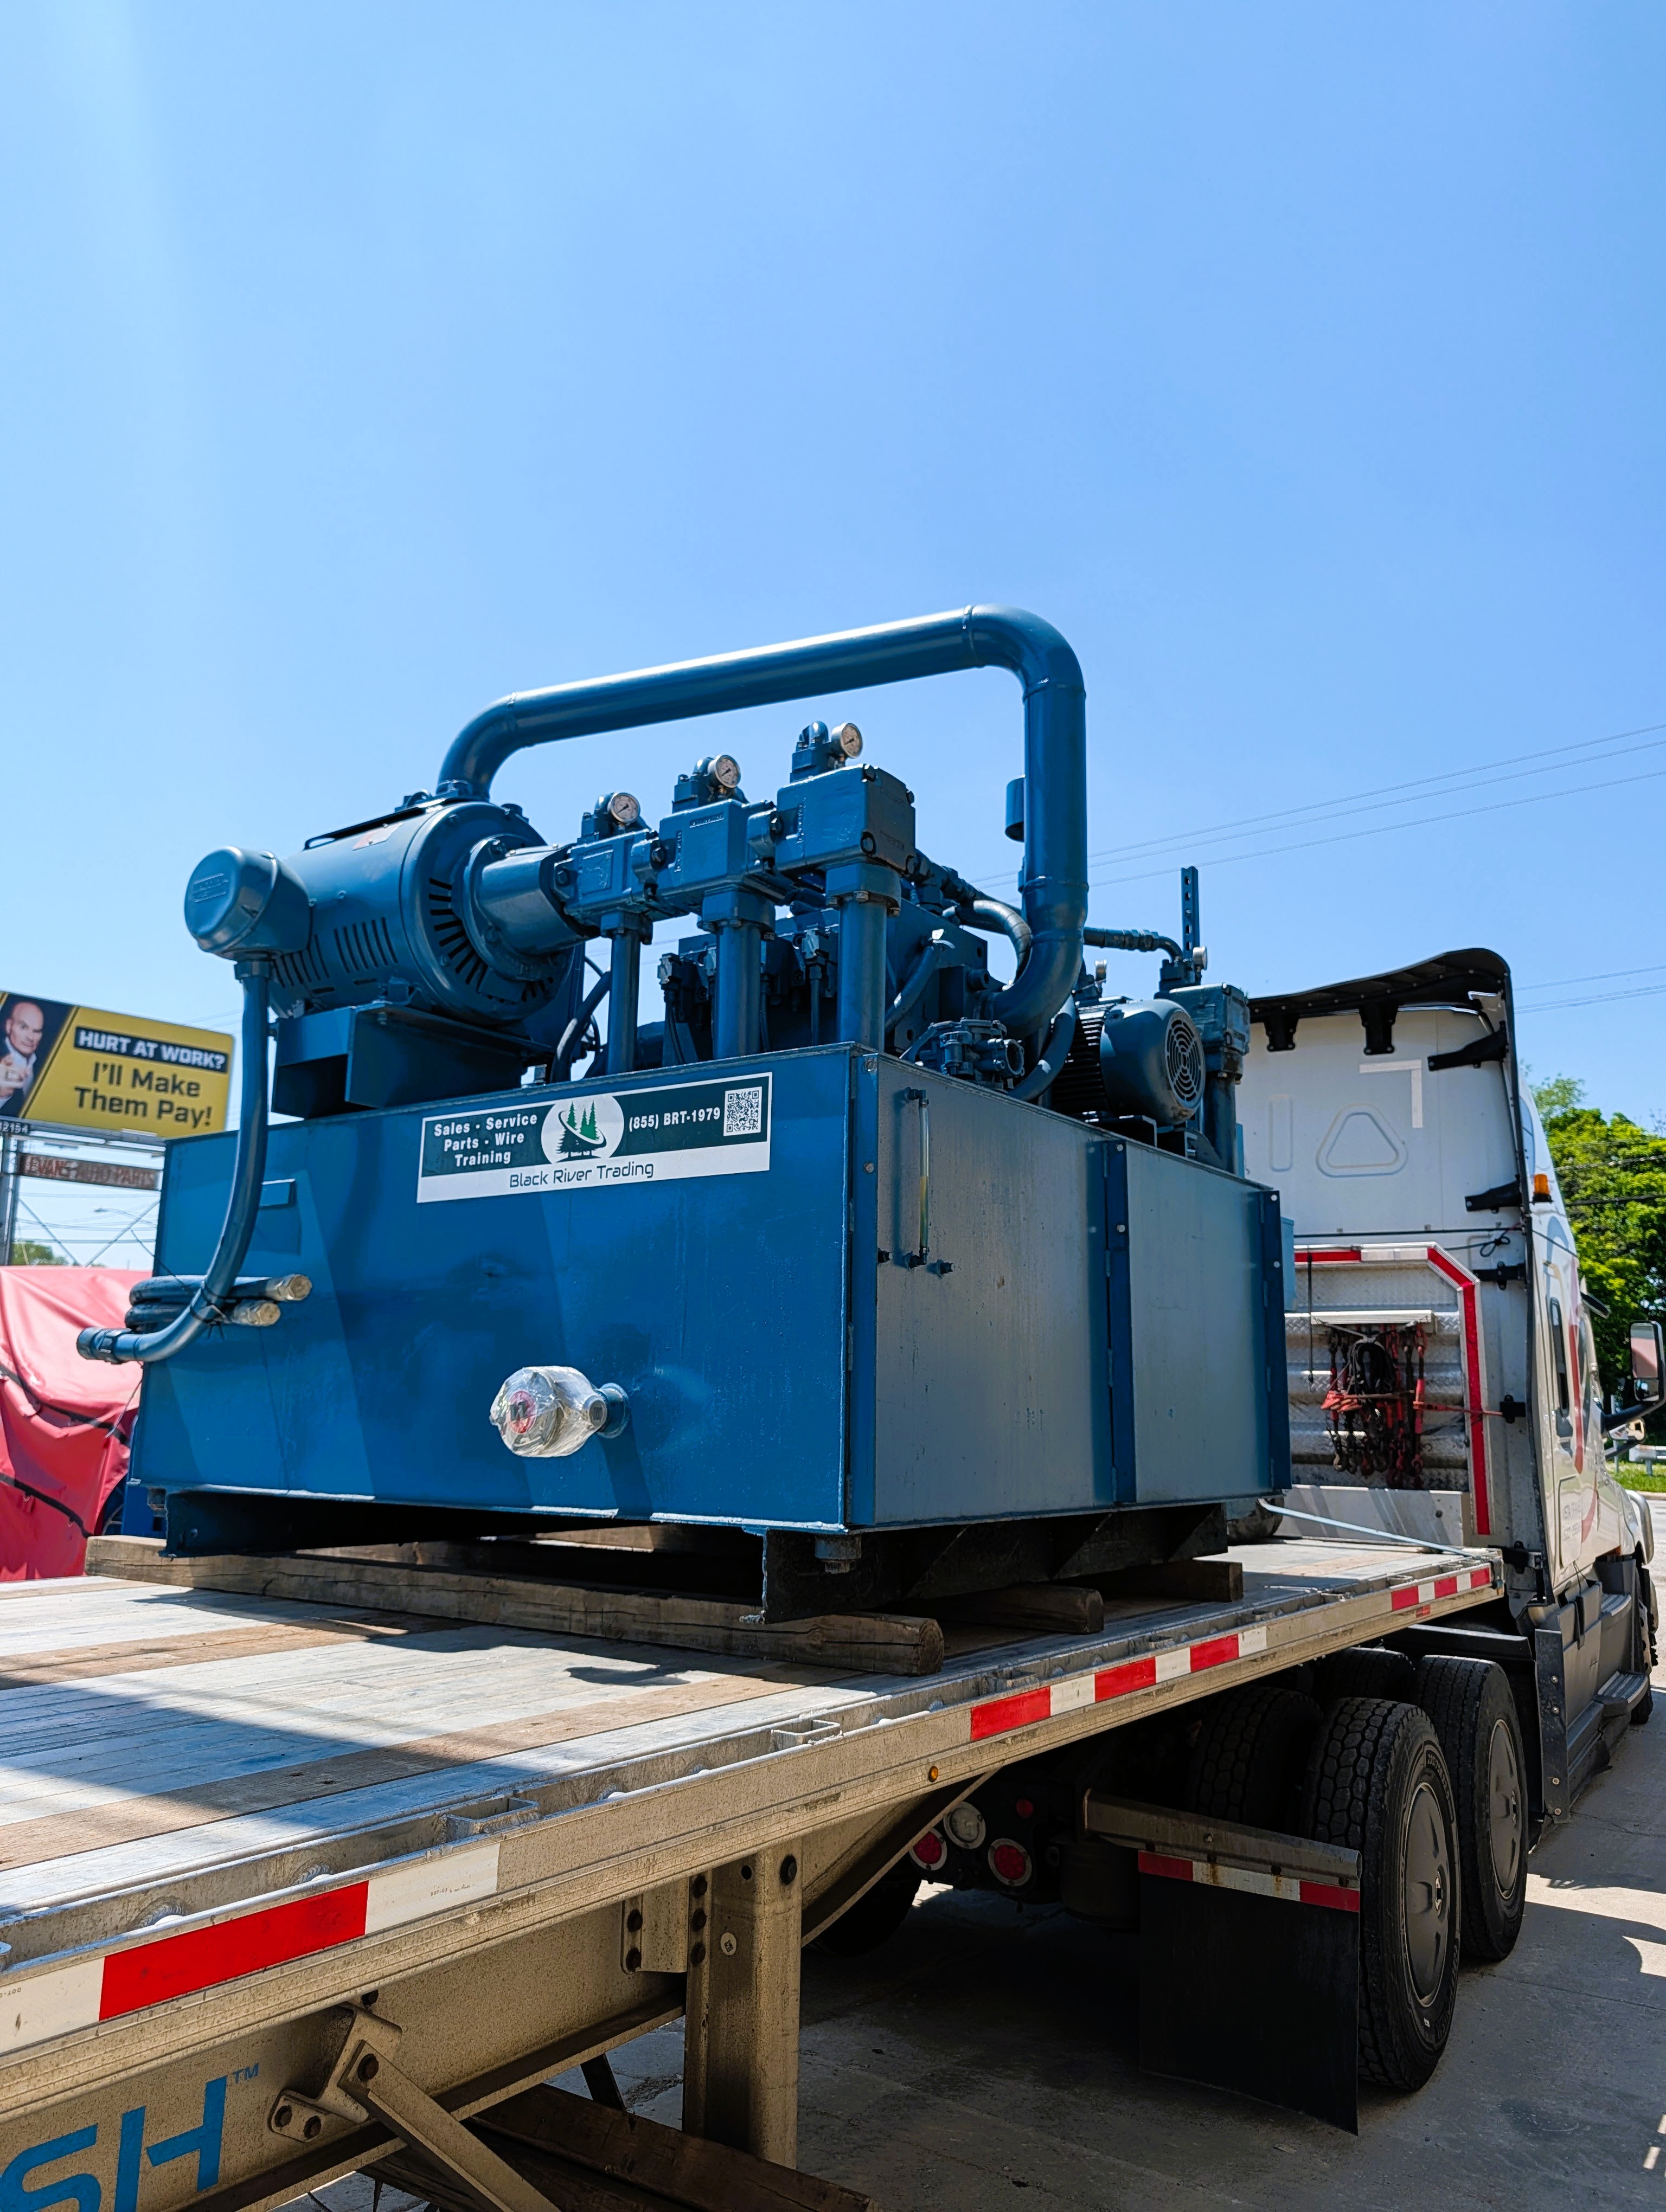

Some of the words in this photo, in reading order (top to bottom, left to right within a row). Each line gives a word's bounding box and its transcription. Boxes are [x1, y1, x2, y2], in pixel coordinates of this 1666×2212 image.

[79, 1030, 131, 1053] HURT
[133, 1040, 158, 1058] AT
[160, 1044, 225, 1070] WORK?
[93, 1062, 123, 1085] I'll
[132, 1068, 201, 1097] Make
[74, 1086, 148, 1117] Them
[157, 1099, 212, 1129] Pay!
[629, 1114, 659, 1132] (855)
[663, 1107, 721, 1126] BRT-1979
[434, 1122, 470, 1137] Sales
[486, 1113, 537, 1130] Service
[444, 1137, 479, 1152] Parts
[495, 1131, 524, 1146] Wire
[454, 1150, 511, 1167] Training
[510, 1171, 549, 1188] Black
[553, 1168, 592, 1184] River
[597, 1161, 654, 1179] Trading
